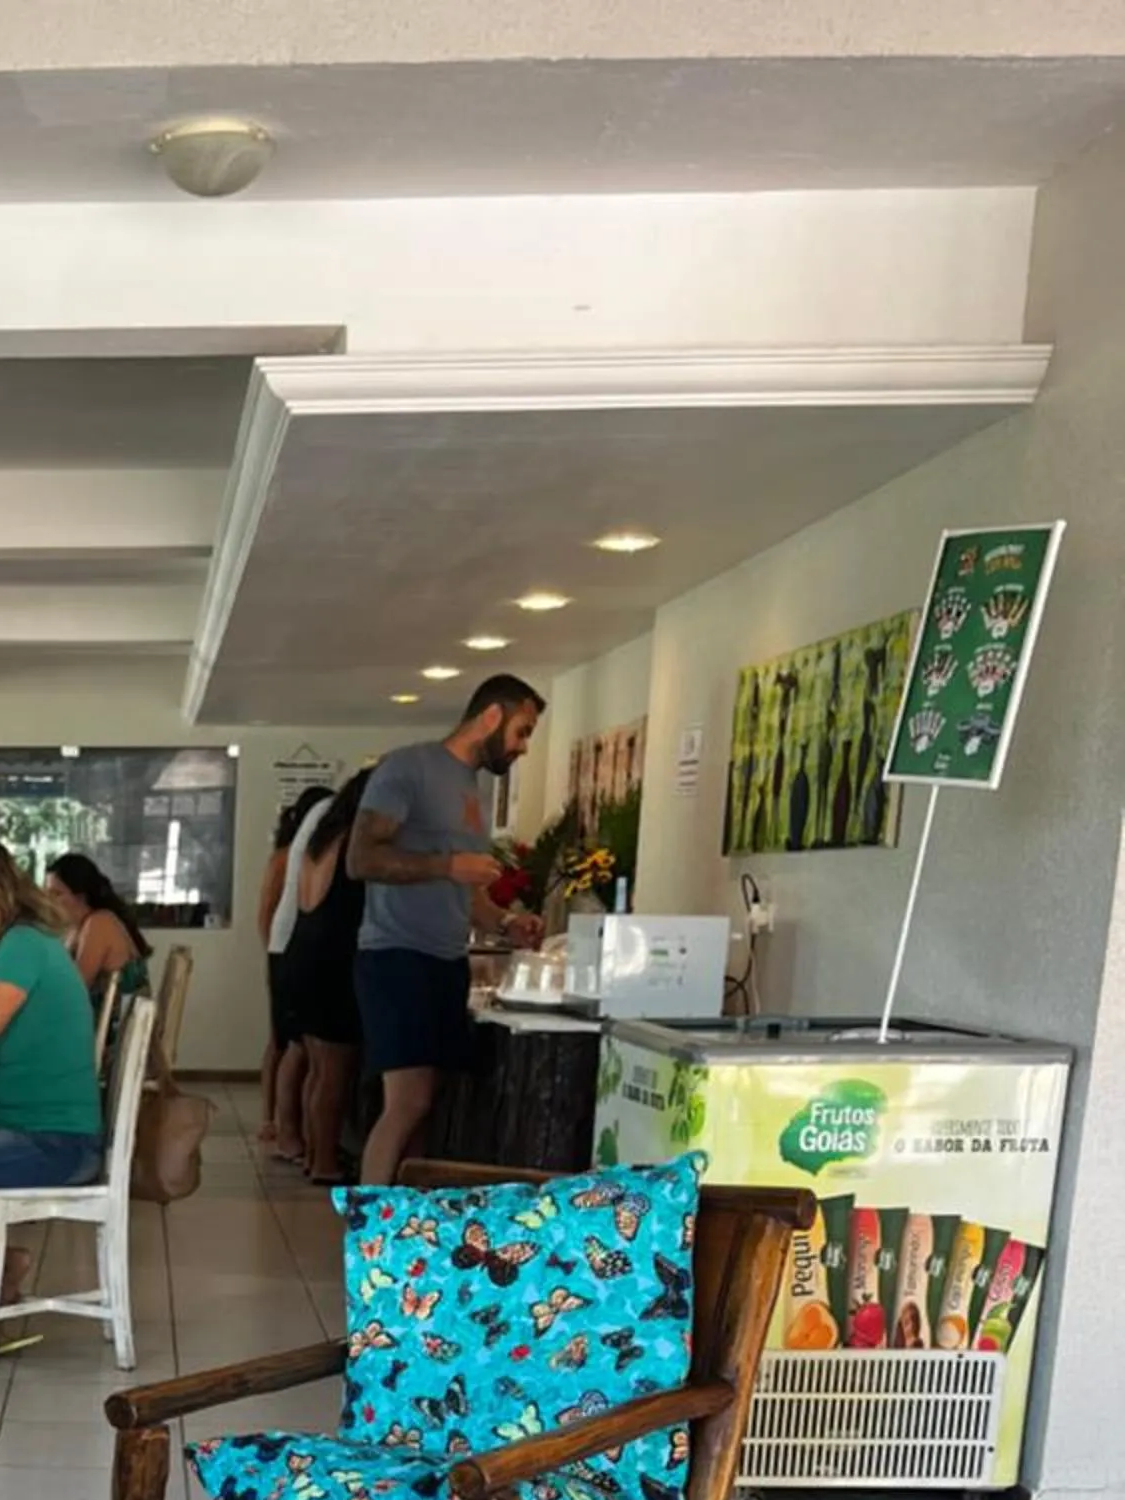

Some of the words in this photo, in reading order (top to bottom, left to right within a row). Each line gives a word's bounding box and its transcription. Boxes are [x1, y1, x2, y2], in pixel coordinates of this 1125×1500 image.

[810, 1103, 875, 1125] Frutos
[798, 1125, 866, 1152] Goiás
[971, 1137, 992, 1153] DA
[1000, 1137, 1050, 1153] FRUTA
[791, 1232, 816, 1298] Pequi
